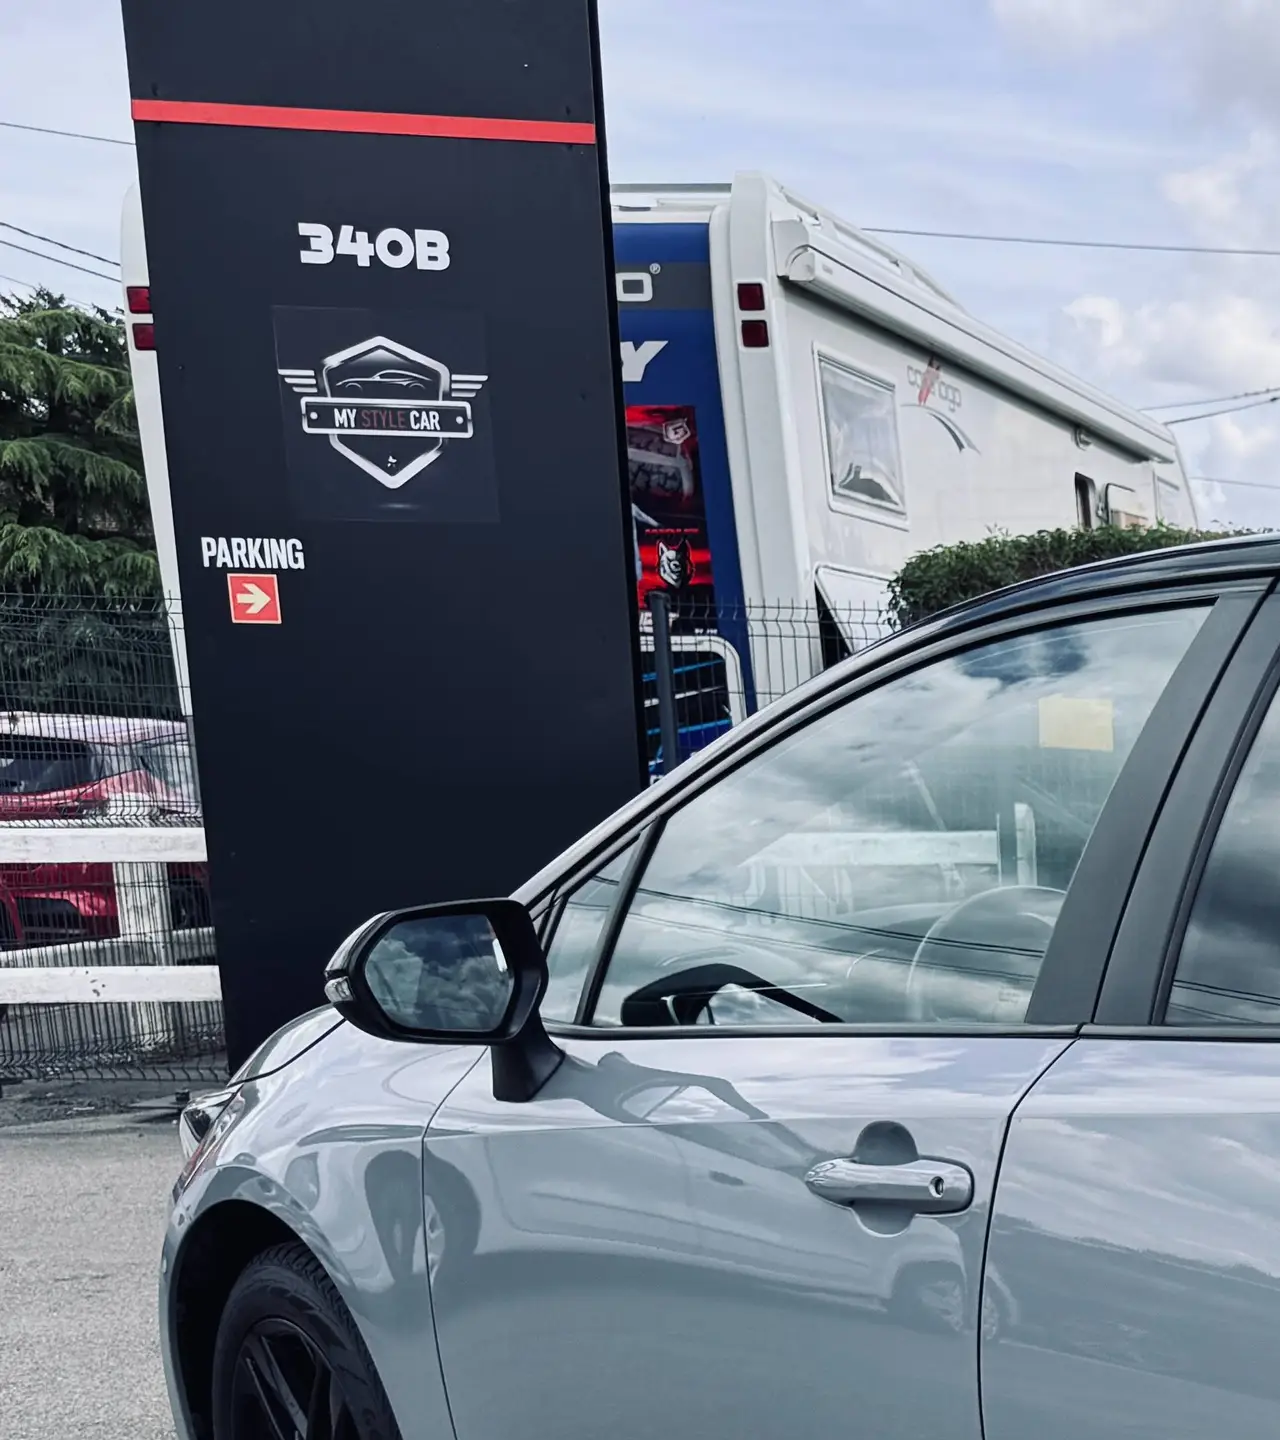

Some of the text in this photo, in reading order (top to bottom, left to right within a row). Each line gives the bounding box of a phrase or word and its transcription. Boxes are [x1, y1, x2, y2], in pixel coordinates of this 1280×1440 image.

[333, 408, 441, 431] MY STYLE CAR
[201, 536, 305, 570] PARKING
